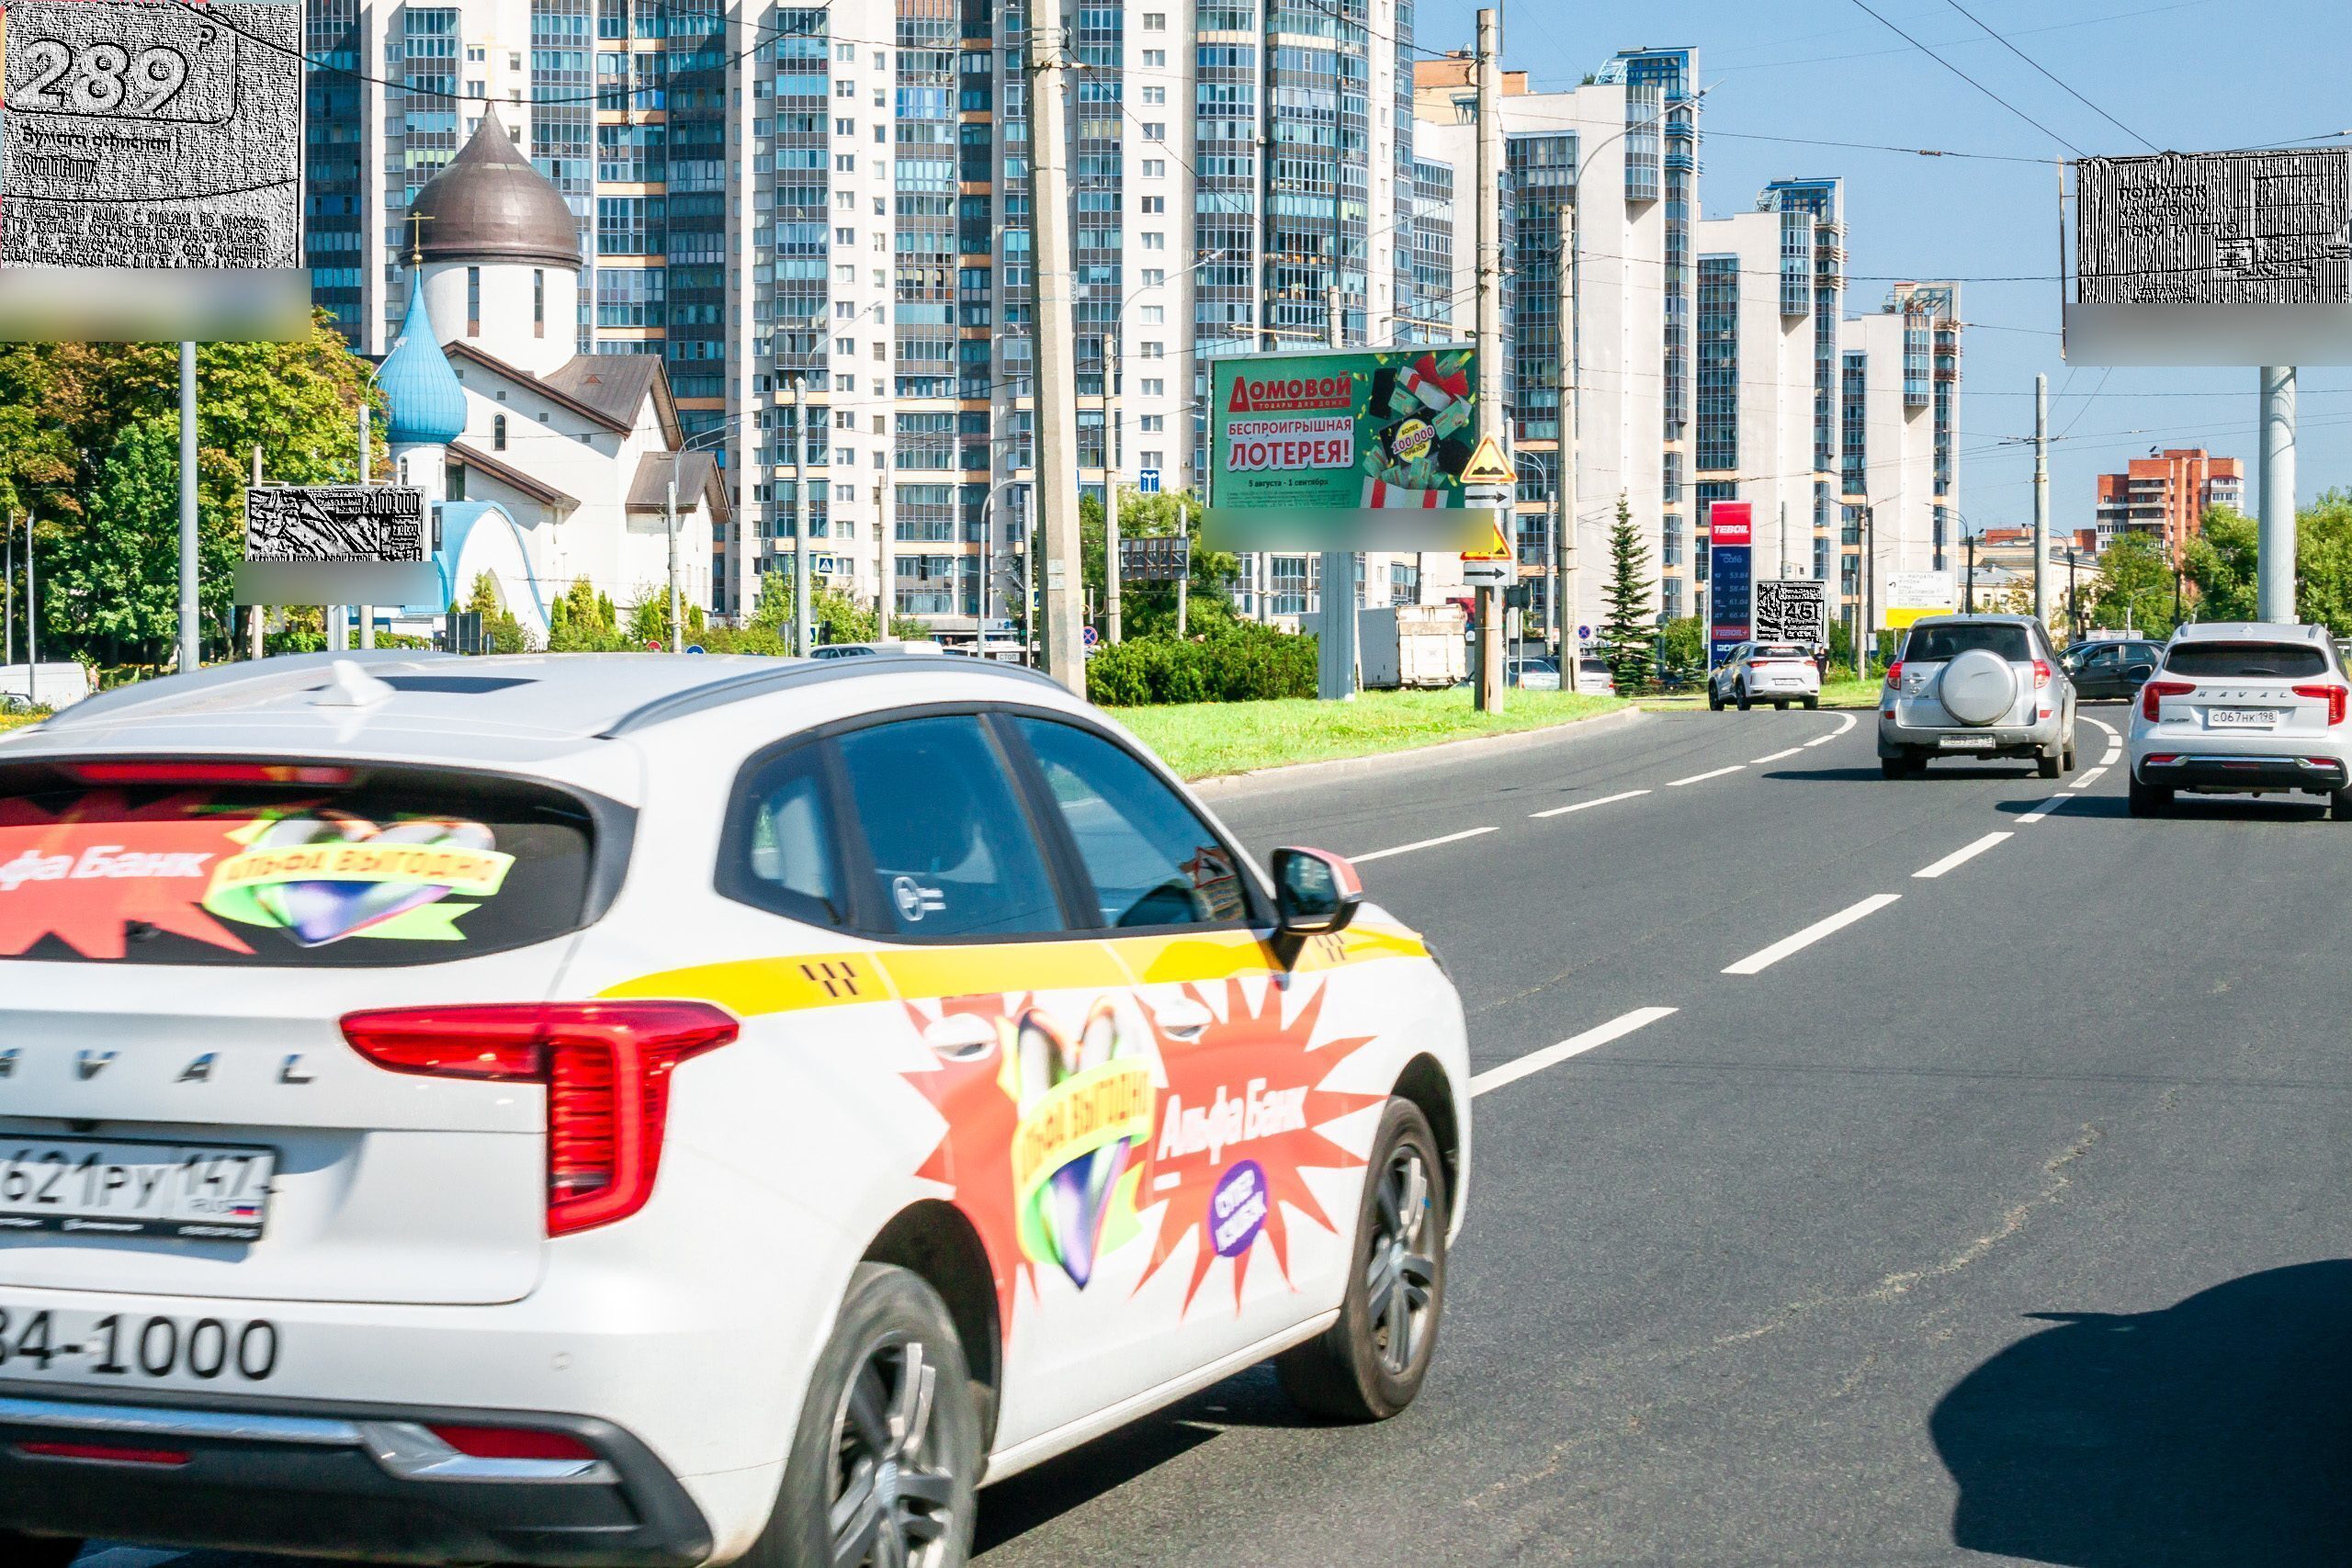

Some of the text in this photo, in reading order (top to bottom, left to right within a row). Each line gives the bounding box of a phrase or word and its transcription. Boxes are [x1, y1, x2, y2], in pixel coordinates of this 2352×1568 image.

[13, 38, 189, 115] 289
[1228, 419, 1351, 435] БЕСПРОИГРЫШНАЯ
[1230, 439, 1350, 467] ЛОТЕРЕЯ!
[1288, 479, 1293, 487] 1
[1295, 478, 1329, 487] сентября
[1713, 525, 1750, 535] TEBOIL
[2198, 691, 2287, 699] HAVAL
[2212, 711, 2275, 723] С067НК 198
[72, 845, 217, 880] Банк
[1156, 1077, 1309, 1165] Альфа Банк
[0, 1308, 278, 1380] 4-1000
